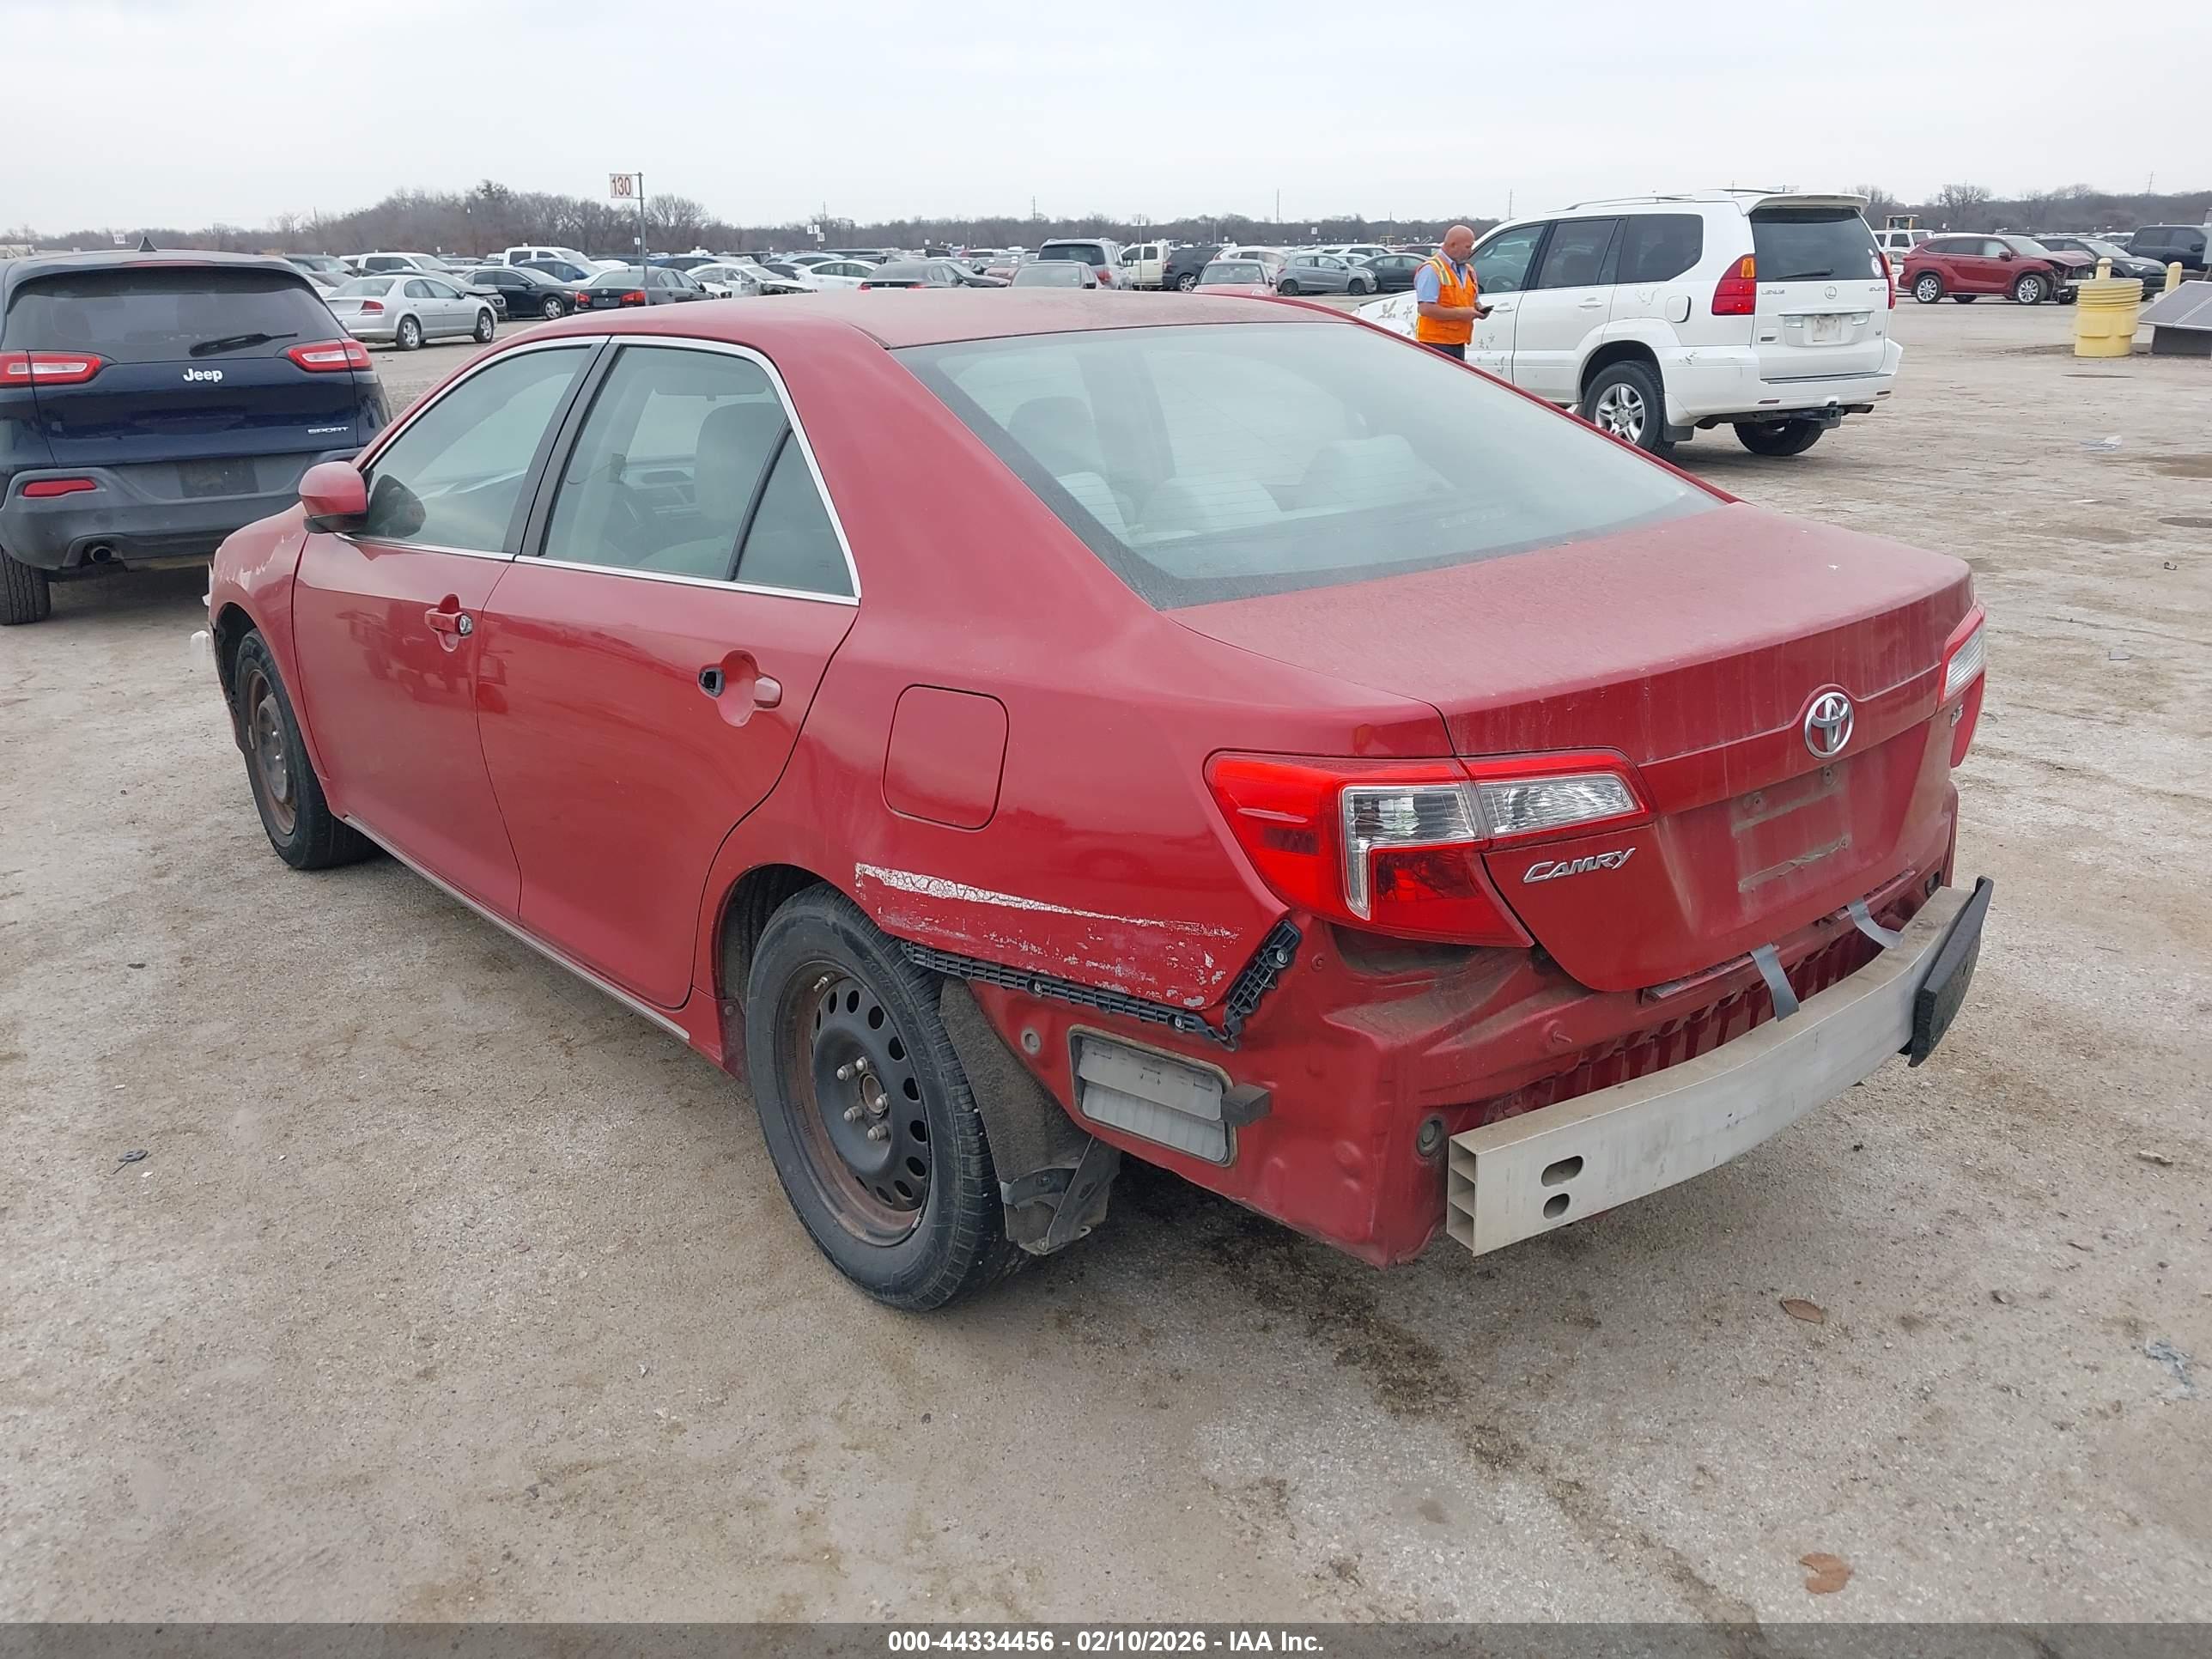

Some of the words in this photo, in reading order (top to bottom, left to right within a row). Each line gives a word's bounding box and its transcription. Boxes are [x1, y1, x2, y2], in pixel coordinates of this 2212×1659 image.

[611, 176, 632, 196] 130
[183, 368, 223, 383] Jeep
[307, 426, 349, 434] SPORT
[1522, 847, 1637, 884] CAMRY
